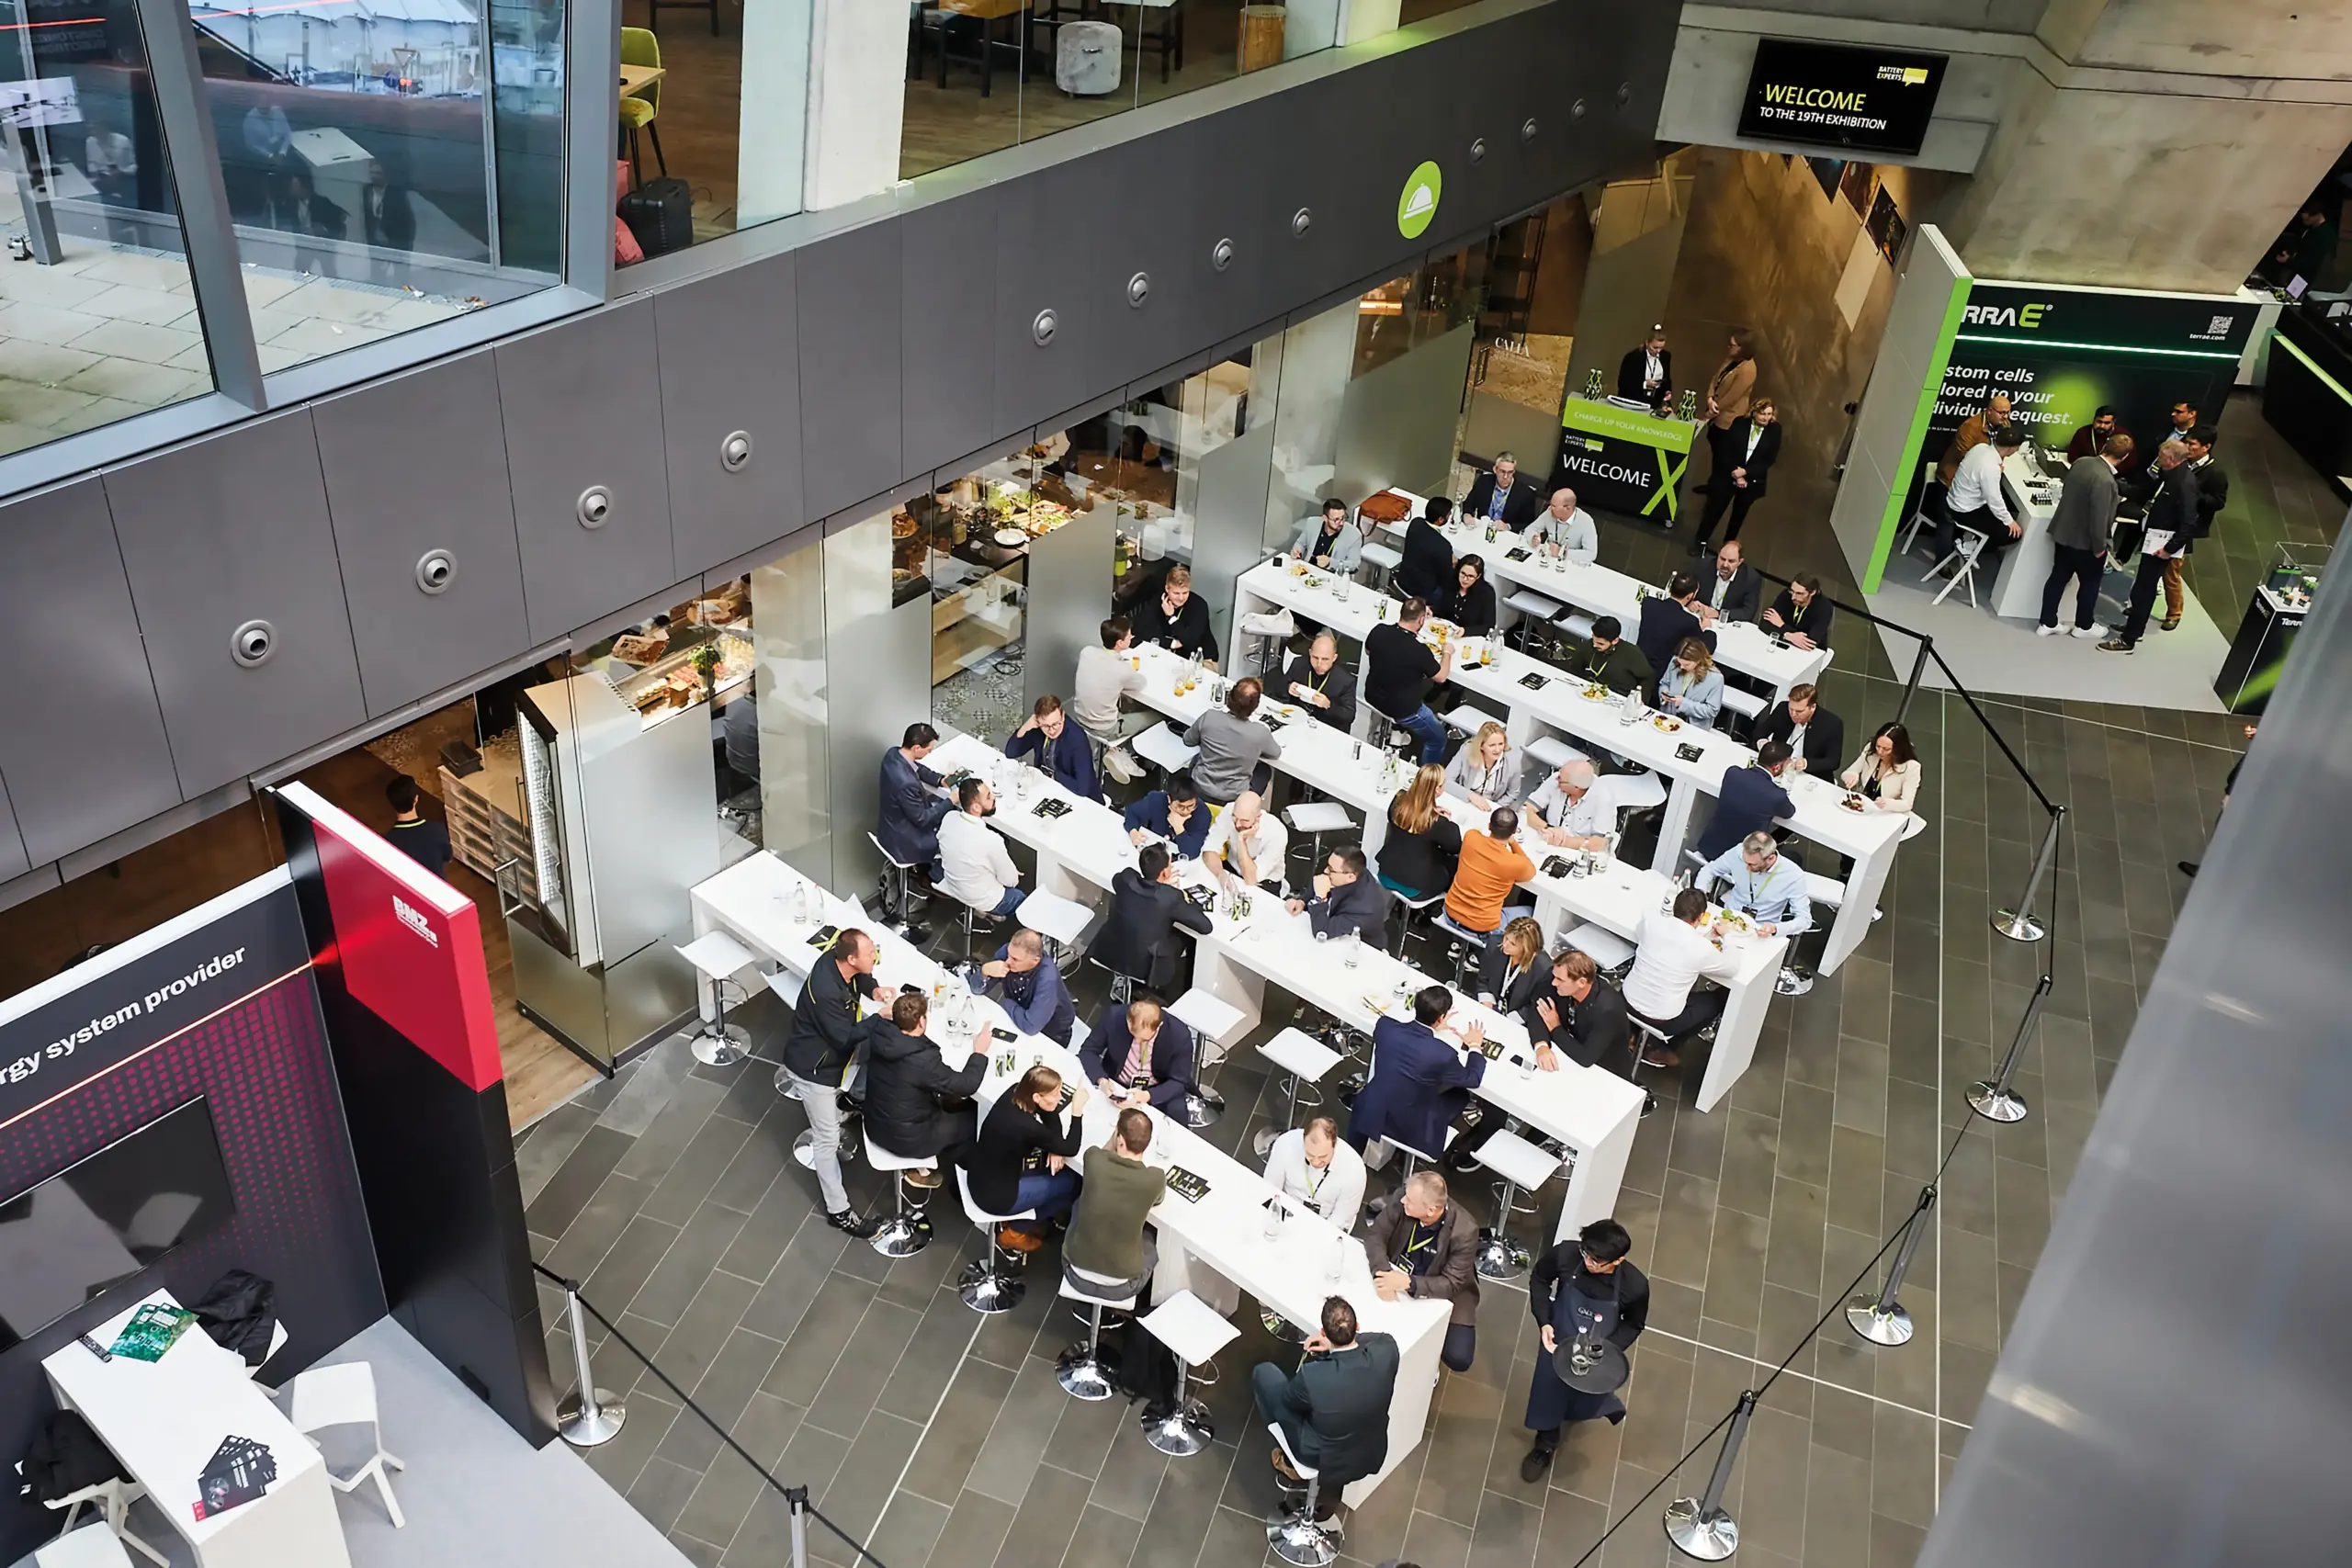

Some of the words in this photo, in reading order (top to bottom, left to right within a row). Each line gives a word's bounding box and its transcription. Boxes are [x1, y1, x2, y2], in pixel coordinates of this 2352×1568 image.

[1876, 73, 1902, 81] EXPERTS
[1878, 65, 1905, 74] BATTERY
[1766, 84, 1867, 111] WELCOME
[1760, 107, 1774, 118] TO
[1776, 108, 1796, 120] THE
[1797, 111, 1825, 123] 19TH
[1826, 114, 1887, 130] EXHIBITION
[1995, 368, 2035, 383] cells
[2011, 390, 2055, 405] your
[2008, 410, 2074, 425] equest.
[1574, 412, 1603, 423] CHARGE
[1615, 421, 1635, 430] YOUR
[1636, 425, 1682, 442] KNOWLEDGE
[1565, 439, 1584, 447] EXPERTS
[1566, 434, 1585, 443] BATTERY
[1563, 454, 1652, 488] WELCOME
[0, 1051, 40, 1085] rgy
[46, 1002, 141, 1058] system
[144, 947, 246, 1013] provider
